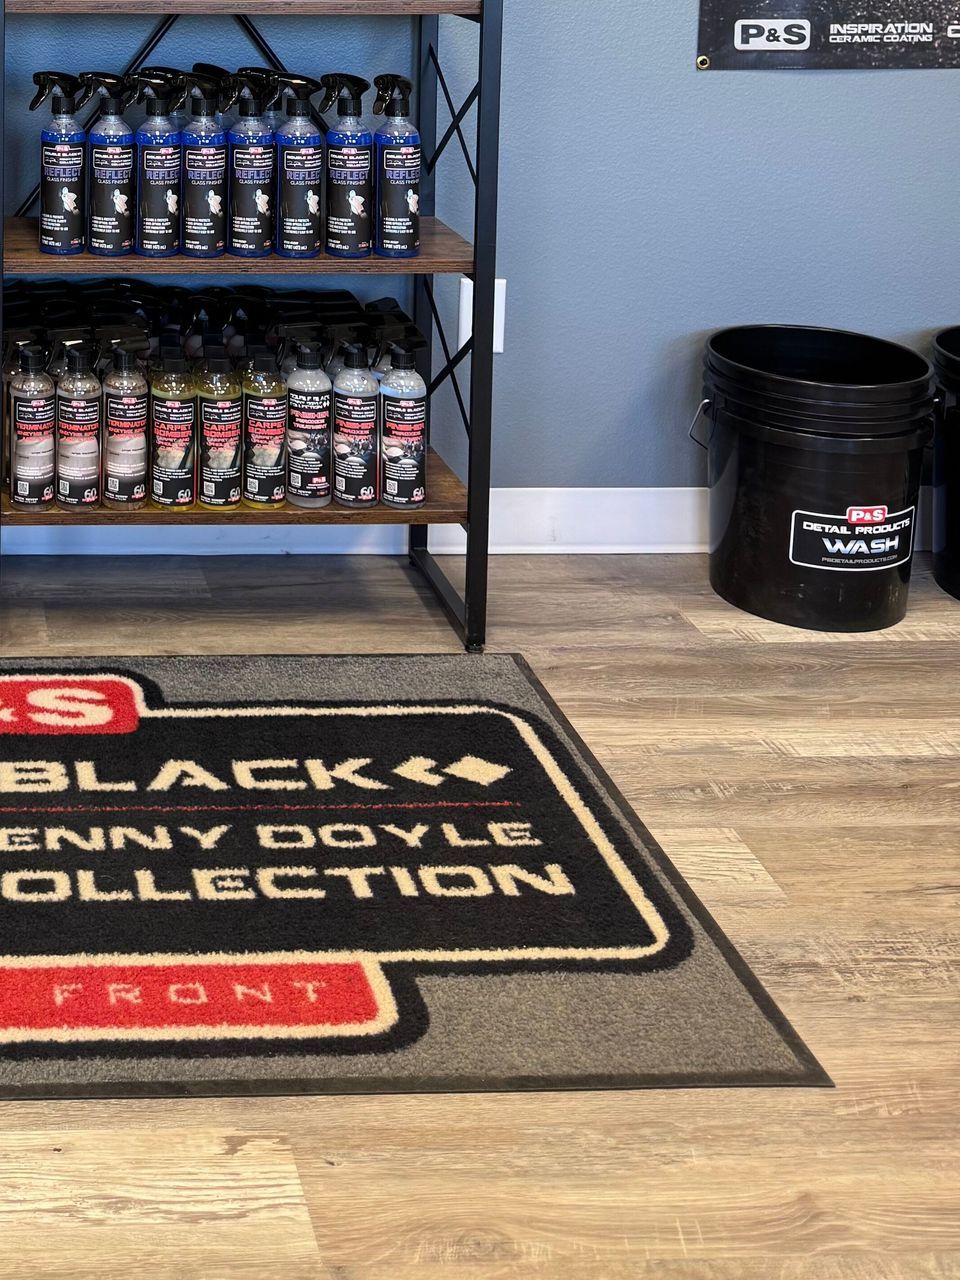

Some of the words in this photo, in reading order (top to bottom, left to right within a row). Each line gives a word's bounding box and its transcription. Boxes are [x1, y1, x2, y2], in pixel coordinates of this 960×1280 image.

[830, 22, 933, 34] INSPIRATION
[740, 23, 807, 45] P&S
[829, 34, 880, 43] CERAMIC
[883, 34, 933, 42] COATING
[44, 167, 81, 178] REFLECT
[95, 169, 131, 180] REFLECT
[188, 170, 225, 180] REFLECT
[330, 170, 368, 180] REFLECT
[154, 421, 192, 431] CARPET
[851, 509, 884, 522] P&S
[802, 521, 851, 535] DETAIL
[855, 517, 910, 535] PRODUCTS
[822, 535, 899, 555] WASH
[821, 554, 898, 564] PSDETAILPRODUCTS.COM
[256, 820, 543, 849] DOYLE
[52, 980, 330, 1009] FRONT
